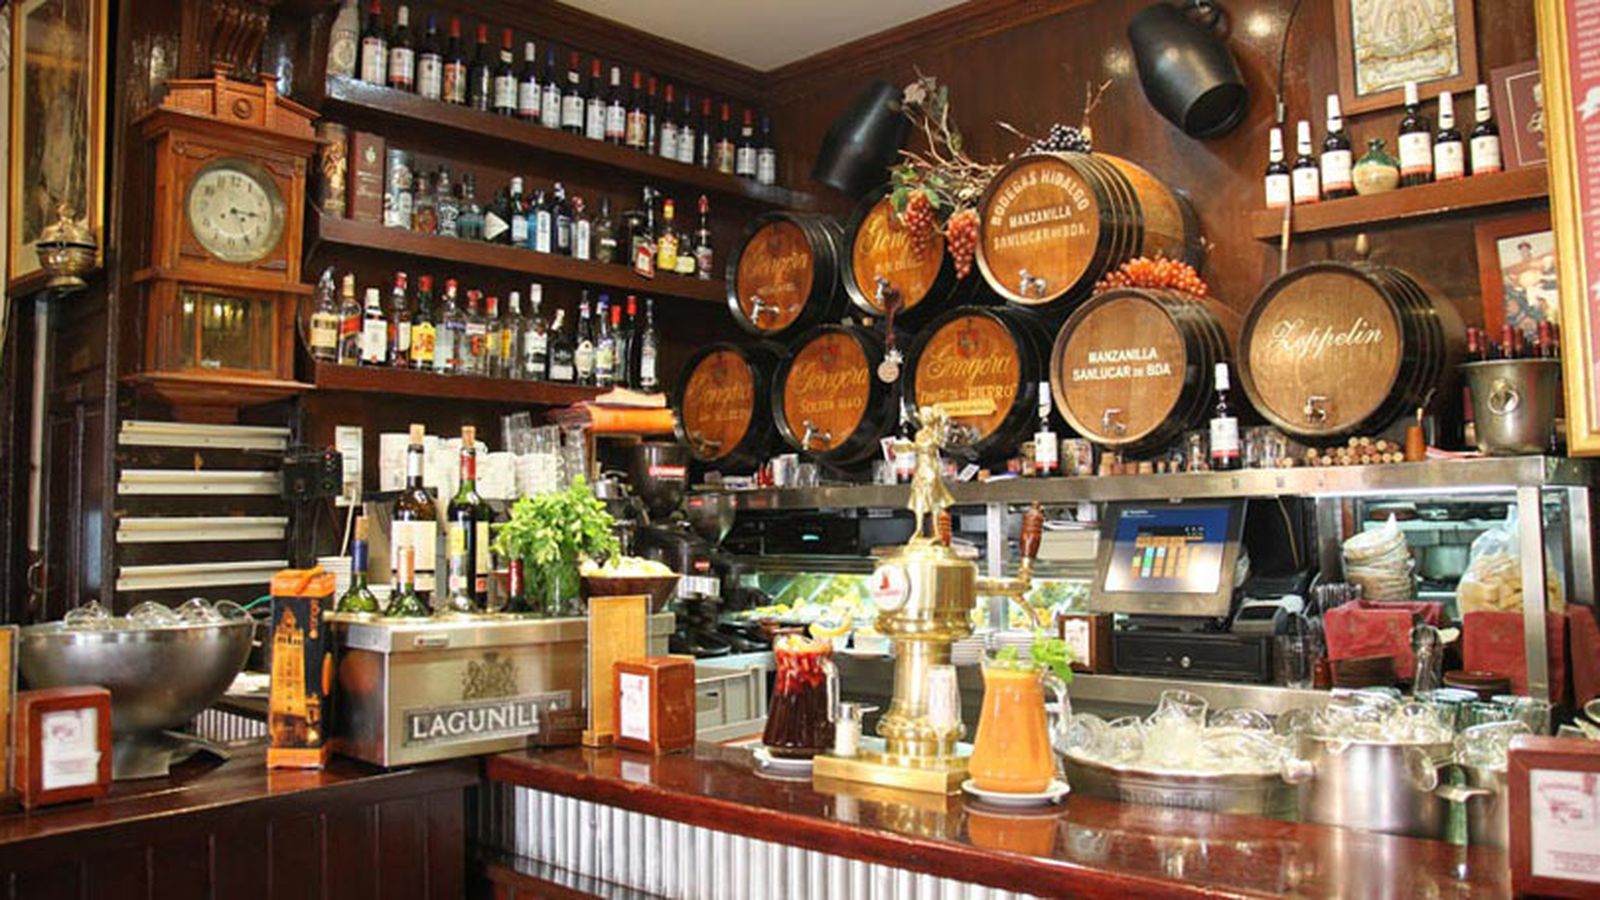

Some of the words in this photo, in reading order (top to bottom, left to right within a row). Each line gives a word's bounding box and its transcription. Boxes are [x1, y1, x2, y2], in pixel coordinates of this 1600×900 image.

[990, 170, 1037, 227] BODEGAS
[1041, 168, 1091, 212] HIDALGO
[1009, 205, 1073, 229] MANZANILLA
[994, 227, 1050, 251] SANLUCAR
[1268, 316, 1384, 360] Zeppelin
[1088, 347, 1158, 363] MANZANILLA
[1072, 365, 1131, 382] SANLUCAR
[1146, 363, 1171, 376] BDA
